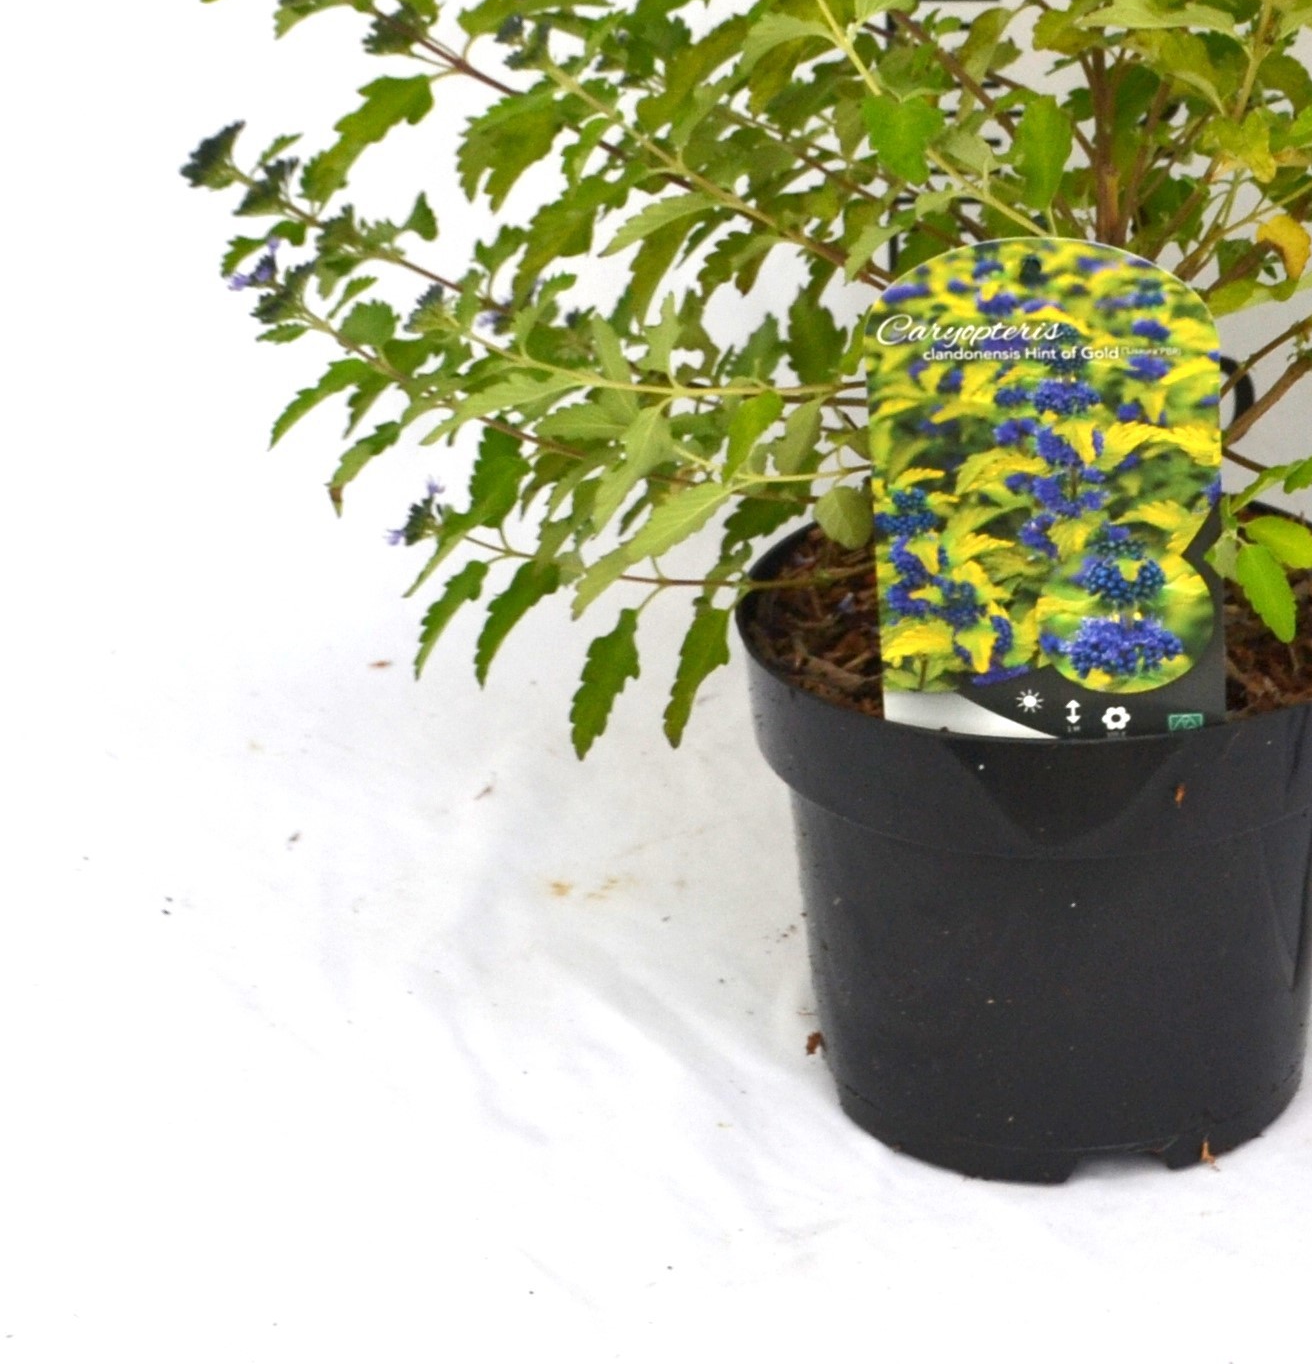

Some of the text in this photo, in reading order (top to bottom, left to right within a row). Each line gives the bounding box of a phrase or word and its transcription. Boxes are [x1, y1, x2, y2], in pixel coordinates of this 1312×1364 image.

[876, 313, 1064, 349] Caryopteris
[922, 347, 1020, 361] clandonensis
[1024, 347, 1056, 360] Hint
[1060, 346, 1078, 360] of
[1080, 346, 1119, 360] Gold
